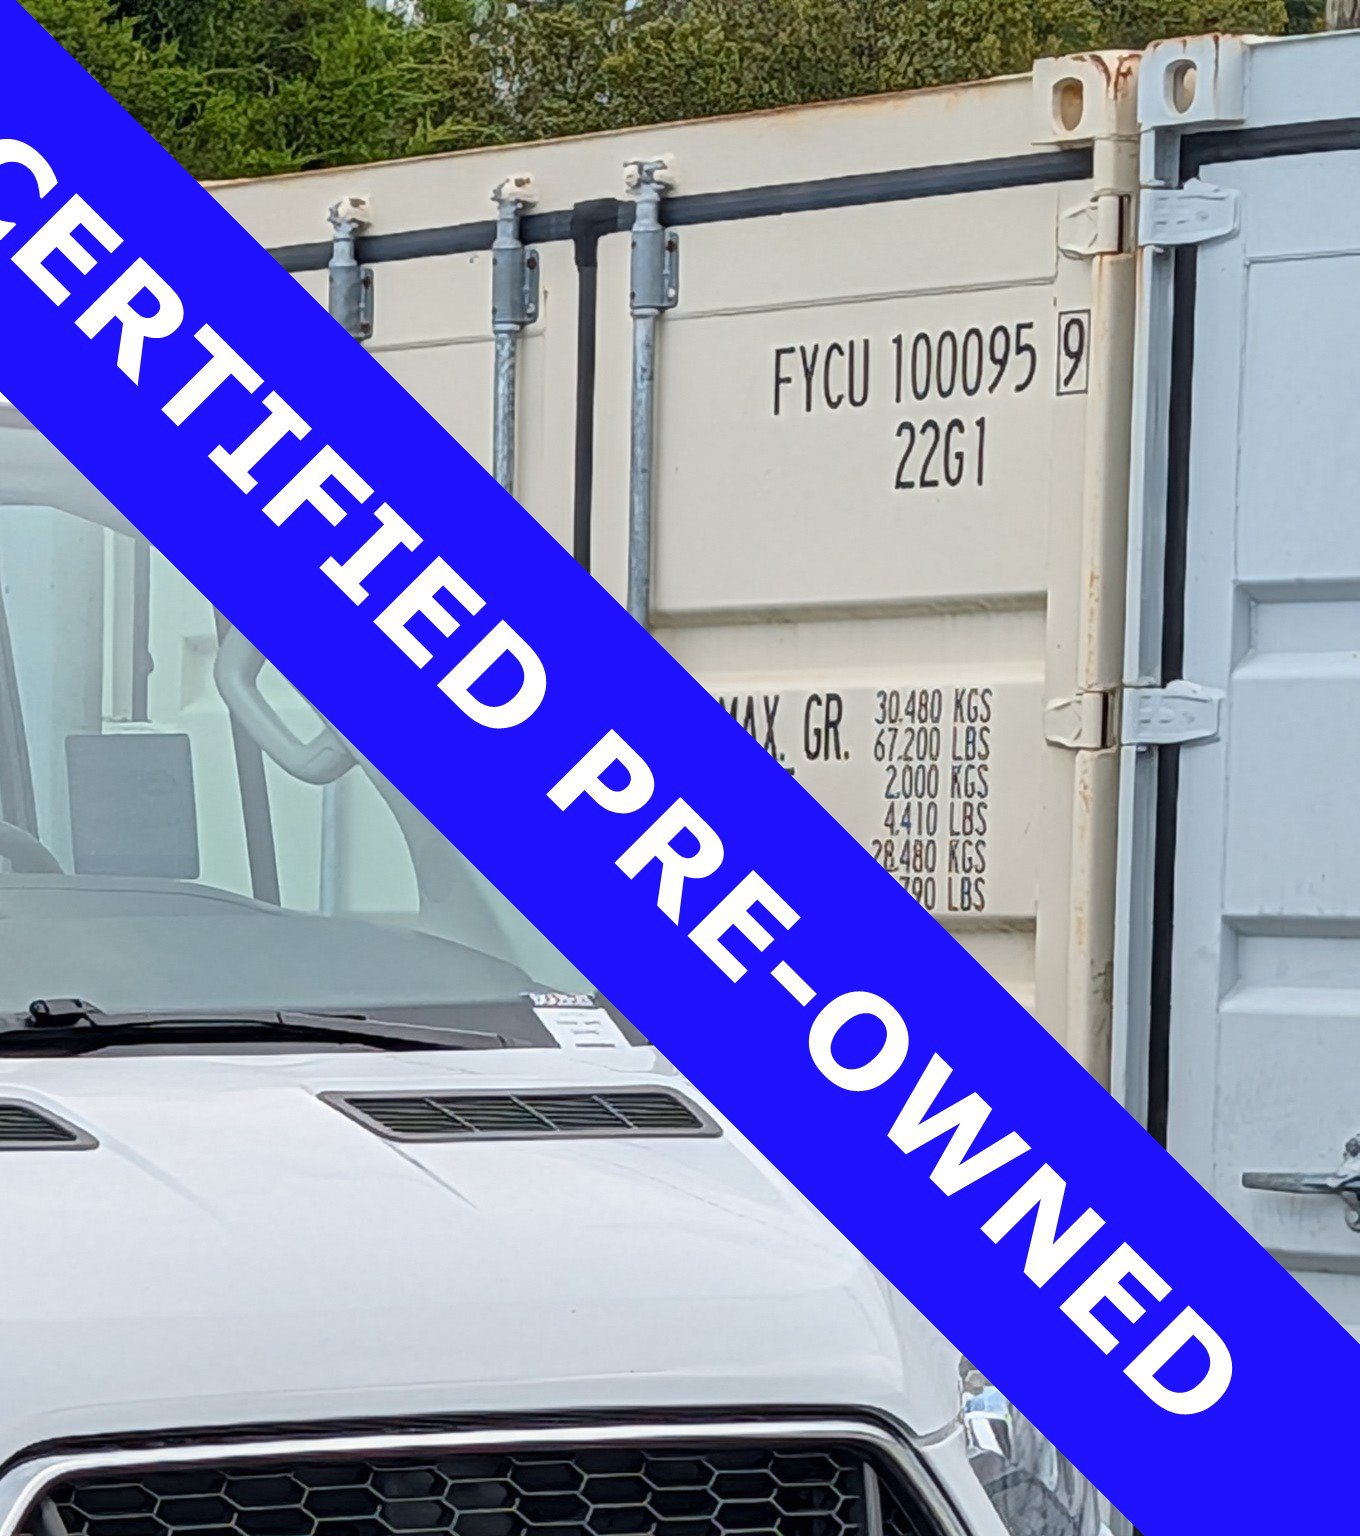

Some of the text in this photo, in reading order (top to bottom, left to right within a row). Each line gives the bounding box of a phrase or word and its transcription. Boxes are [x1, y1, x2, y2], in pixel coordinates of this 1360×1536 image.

[774, 317, 1086, 415] FYCU 100095 9
[894, 416, 986, 490] 22G1
[718, 687, 993, 762] AX. GR. 30.480 KGS
[951, 725, 991, 761] LBS
[950, 763, 989, 799] KGS
[949, 801, 989, 837] LBS
[947, 839, 987, 874] KGS
[947, 876, 986, 912] LBS
